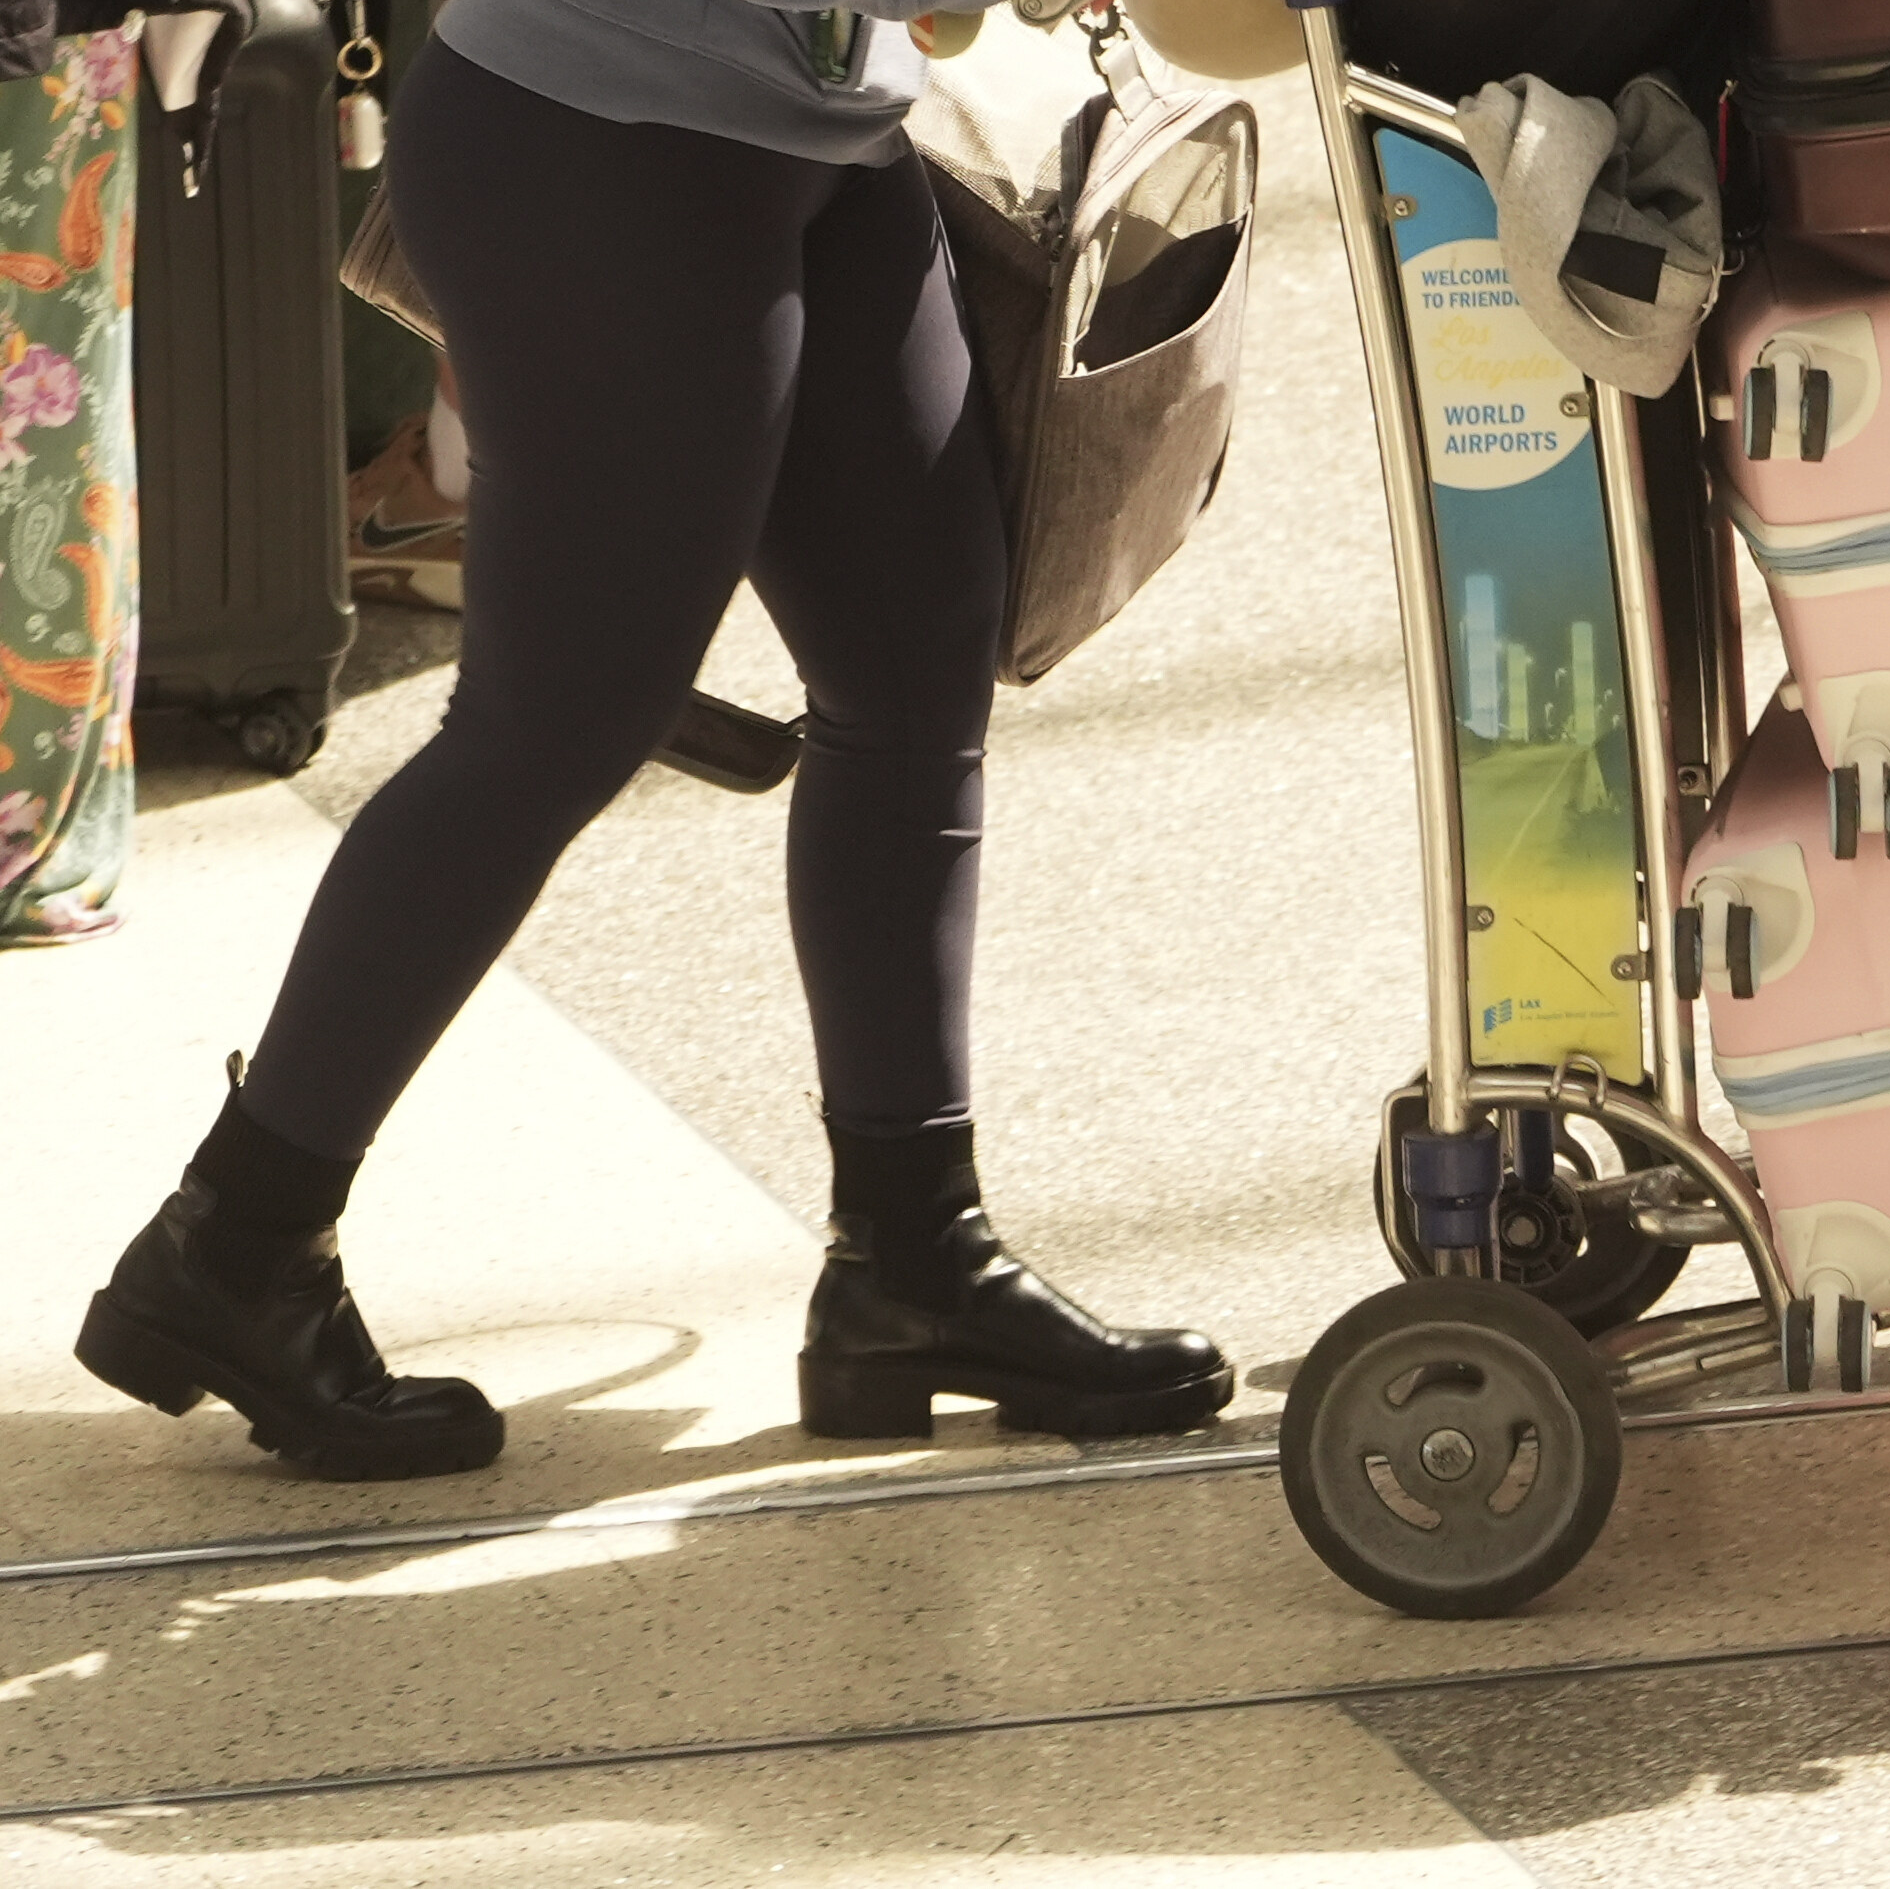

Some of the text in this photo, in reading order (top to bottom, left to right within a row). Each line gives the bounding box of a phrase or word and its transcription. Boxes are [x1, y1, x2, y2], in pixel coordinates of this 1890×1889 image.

[1421, 290, 1521, 309] TO FRIEND
[1433, 353, 1564, 390] Angeles
[1443, 404, 1526, 426] WORLD
[1444, 431, 1559, 455] AIRPORTS
